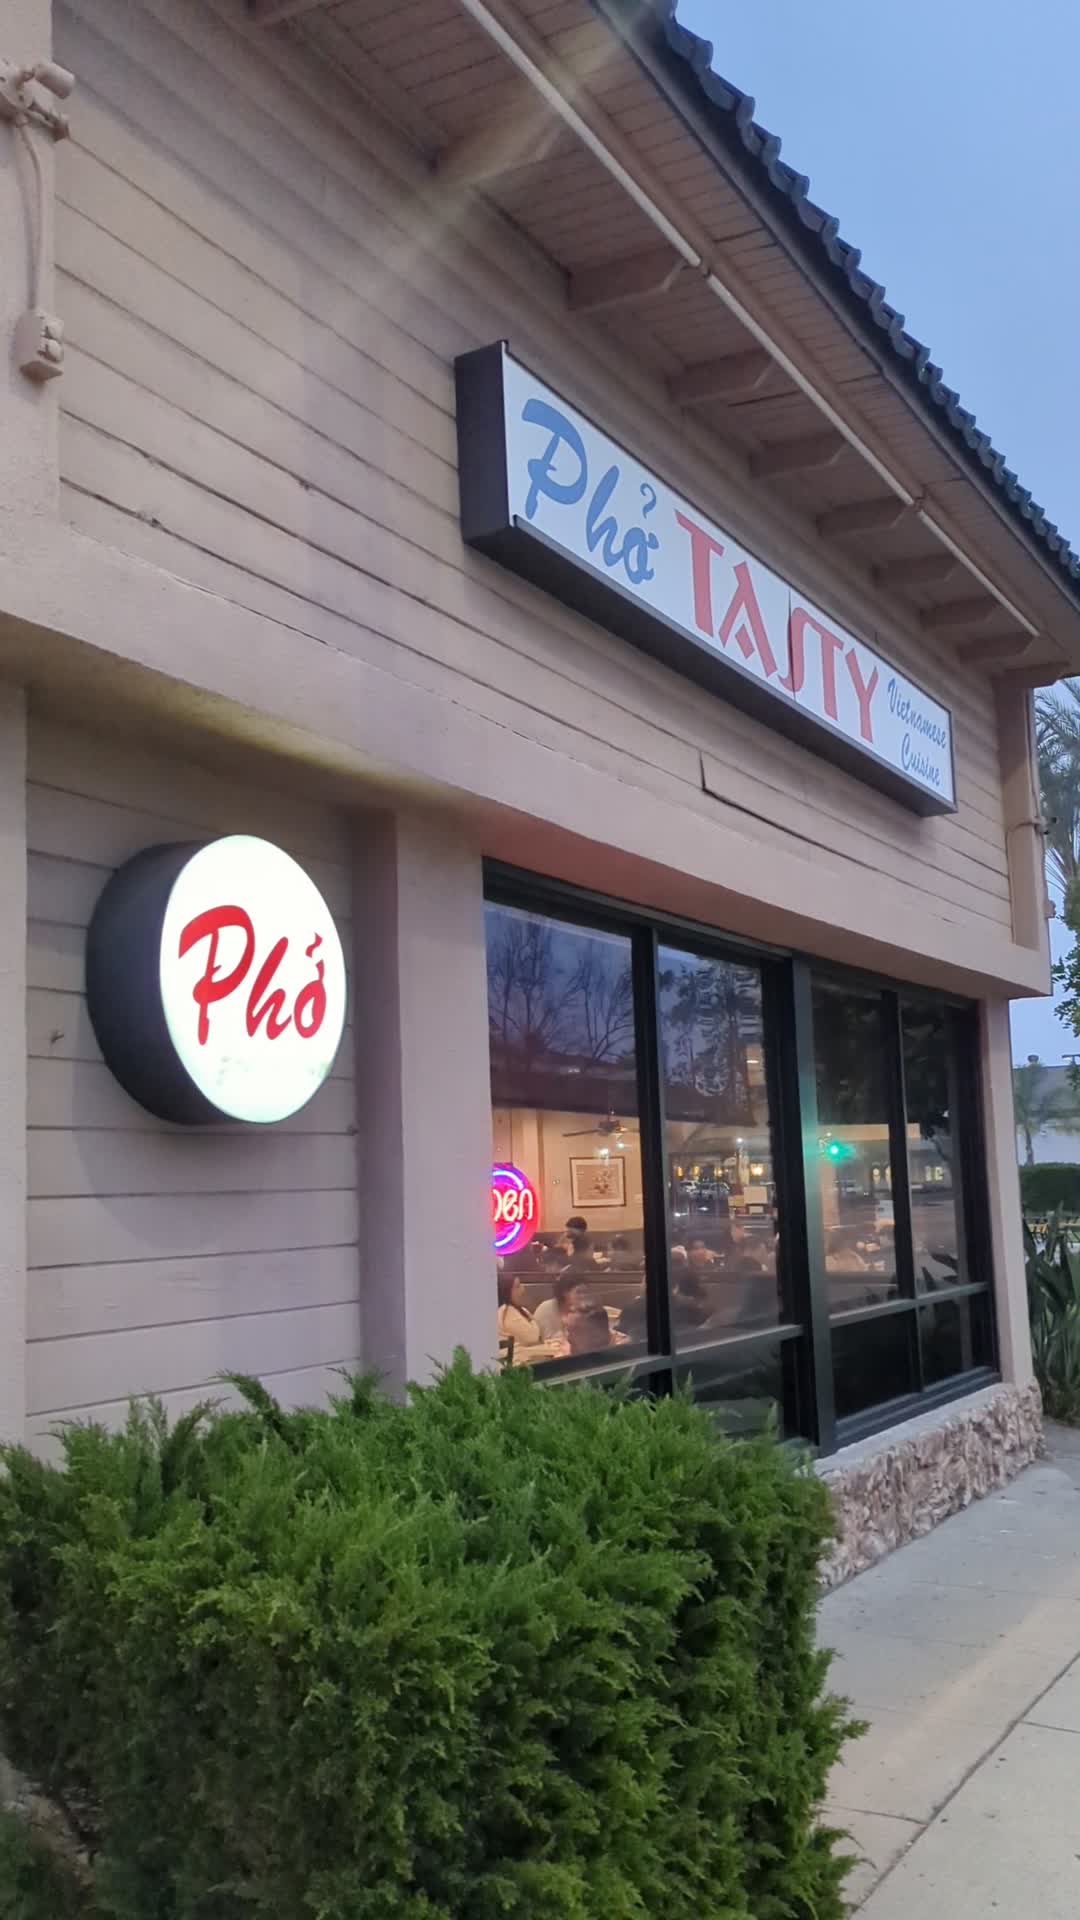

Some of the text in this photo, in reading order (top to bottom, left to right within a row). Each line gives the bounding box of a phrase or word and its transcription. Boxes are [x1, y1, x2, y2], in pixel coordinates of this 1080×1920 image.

[674, 509, 879, 744] TASTY
[887, 677, 947, 749] Vietnamese
[901, 732, 941, 787] Cuisine
